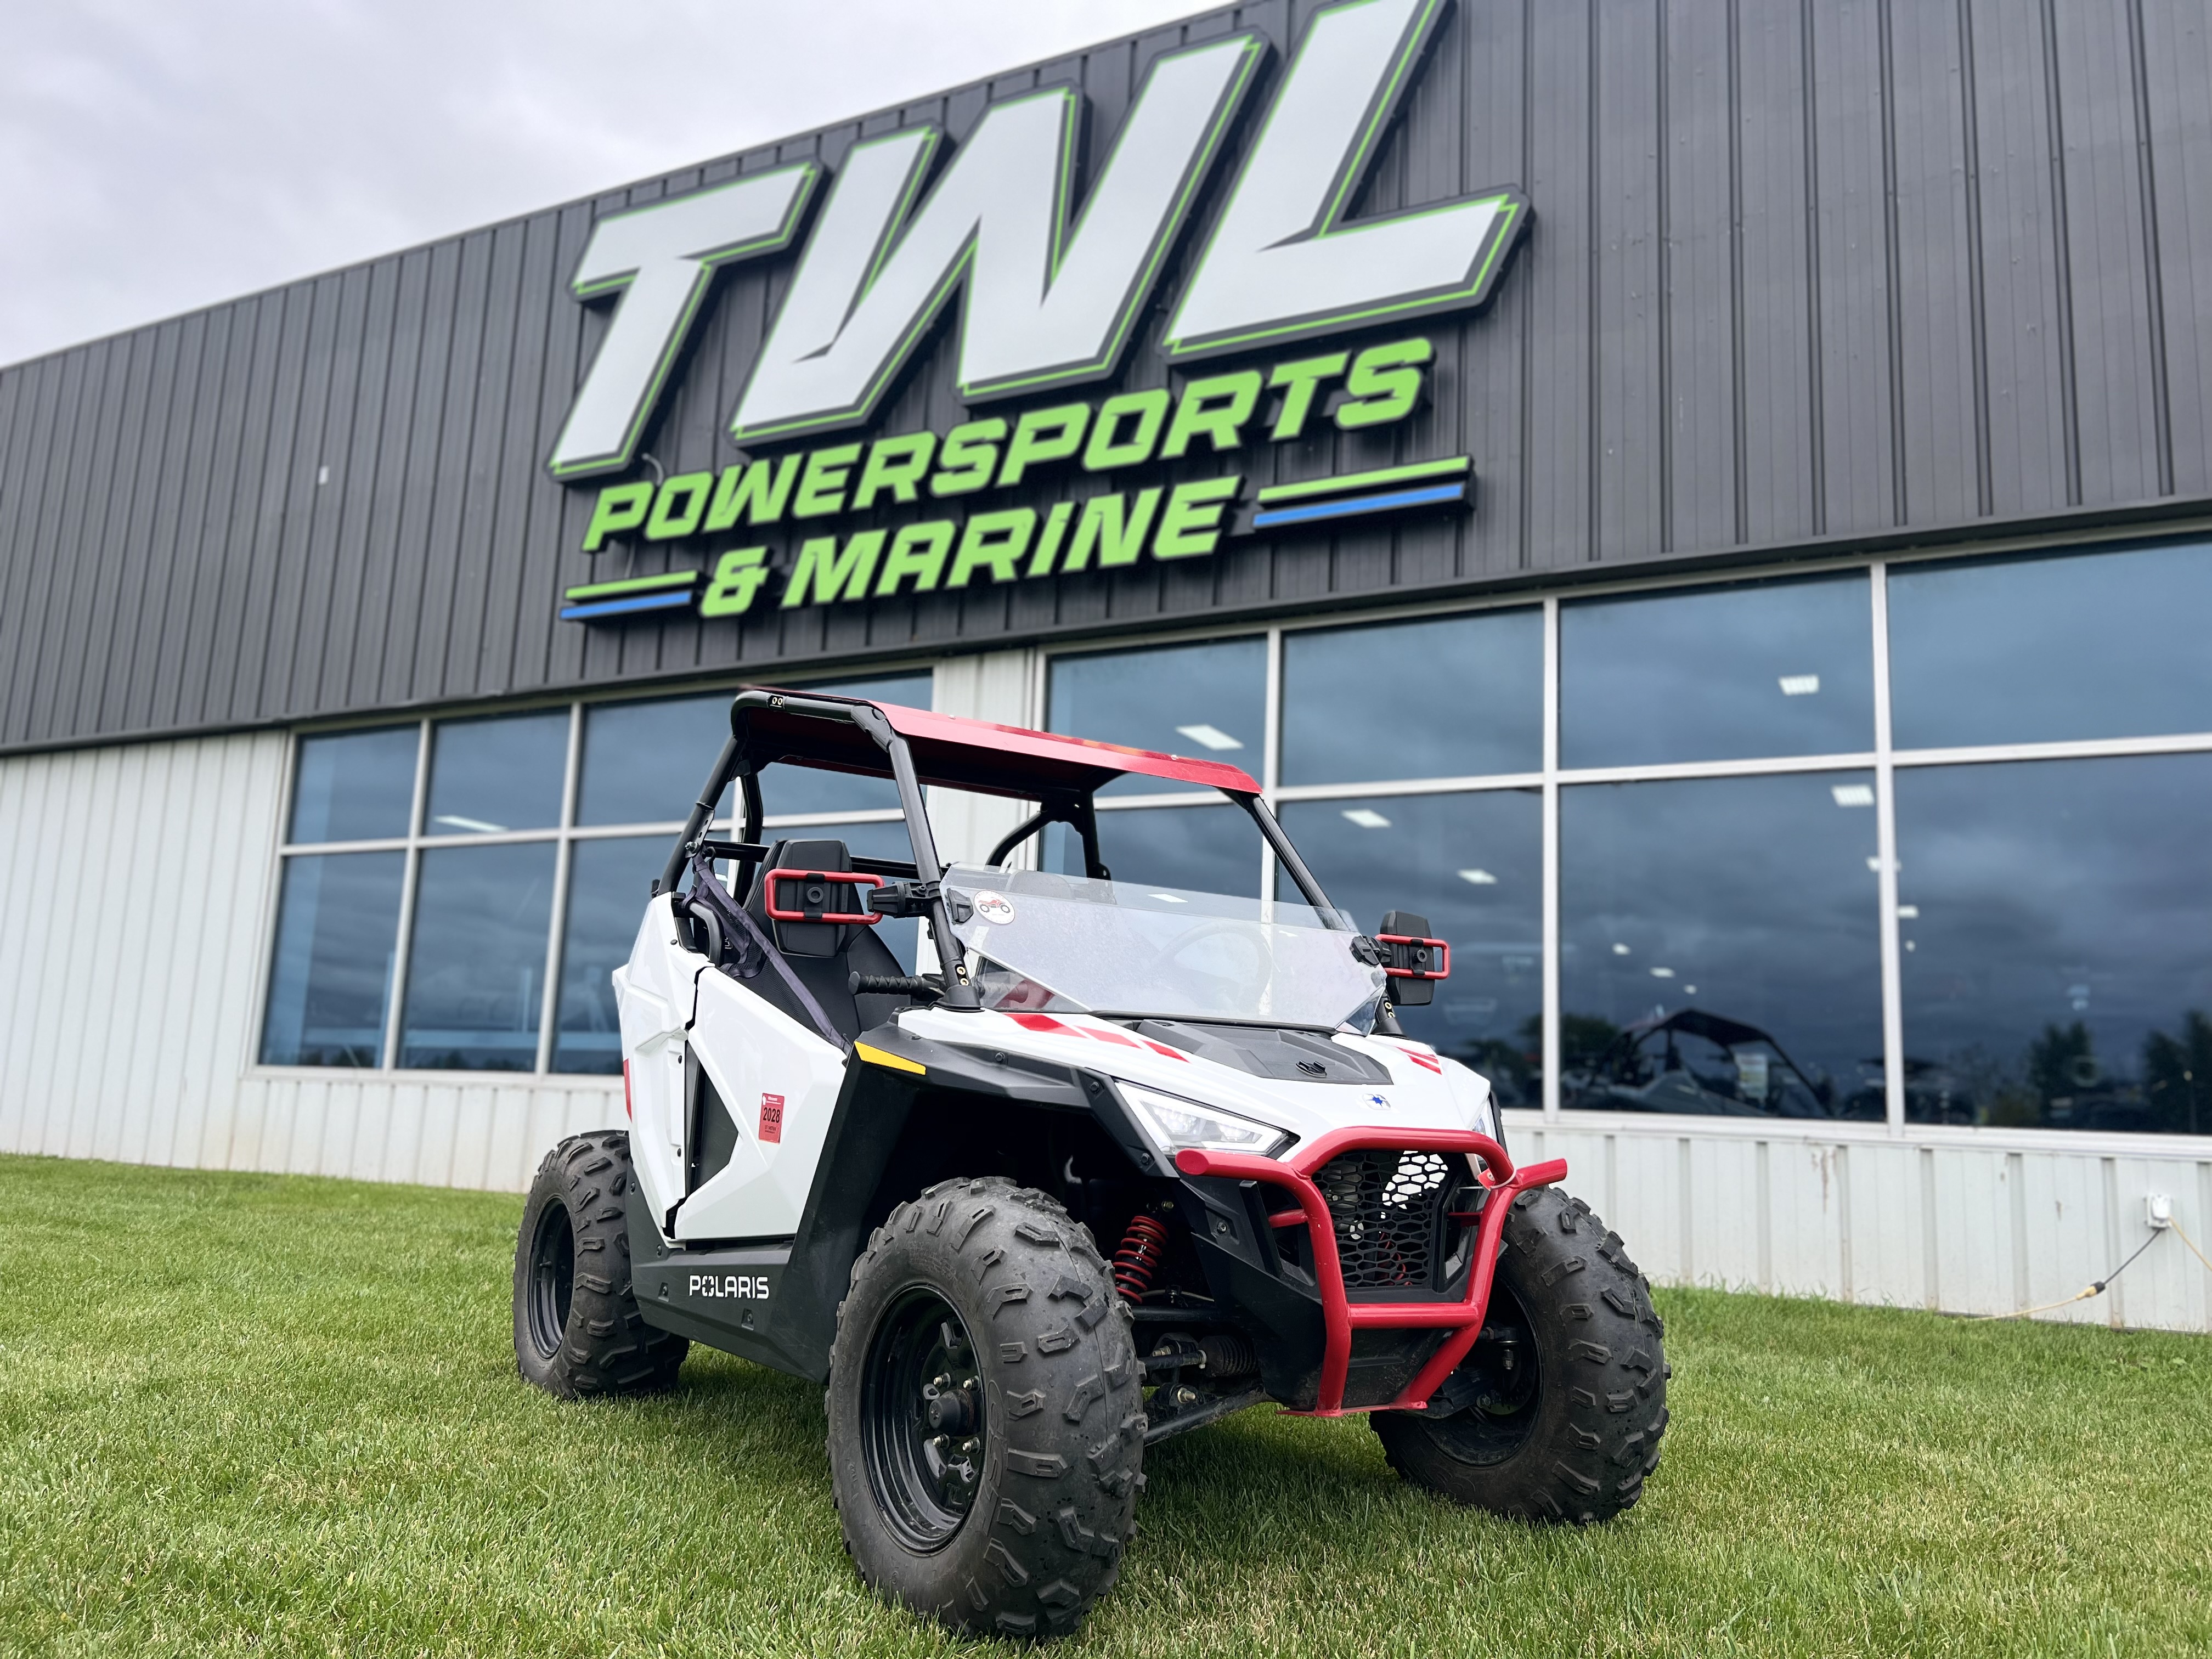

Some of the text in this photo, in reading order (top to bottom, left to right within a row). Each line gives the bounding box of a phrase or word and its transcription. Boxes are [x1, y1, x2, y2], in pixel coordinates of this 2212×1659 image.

[549, 0, 1520, 476] TWL
[582, 338, 1433, 551] POWERSPORTS
[701, 476, 1240, 617] & MARINE
[763, 1107, 781, 1124] 2028
[689, 1275, 769, 1300] POLARIS
